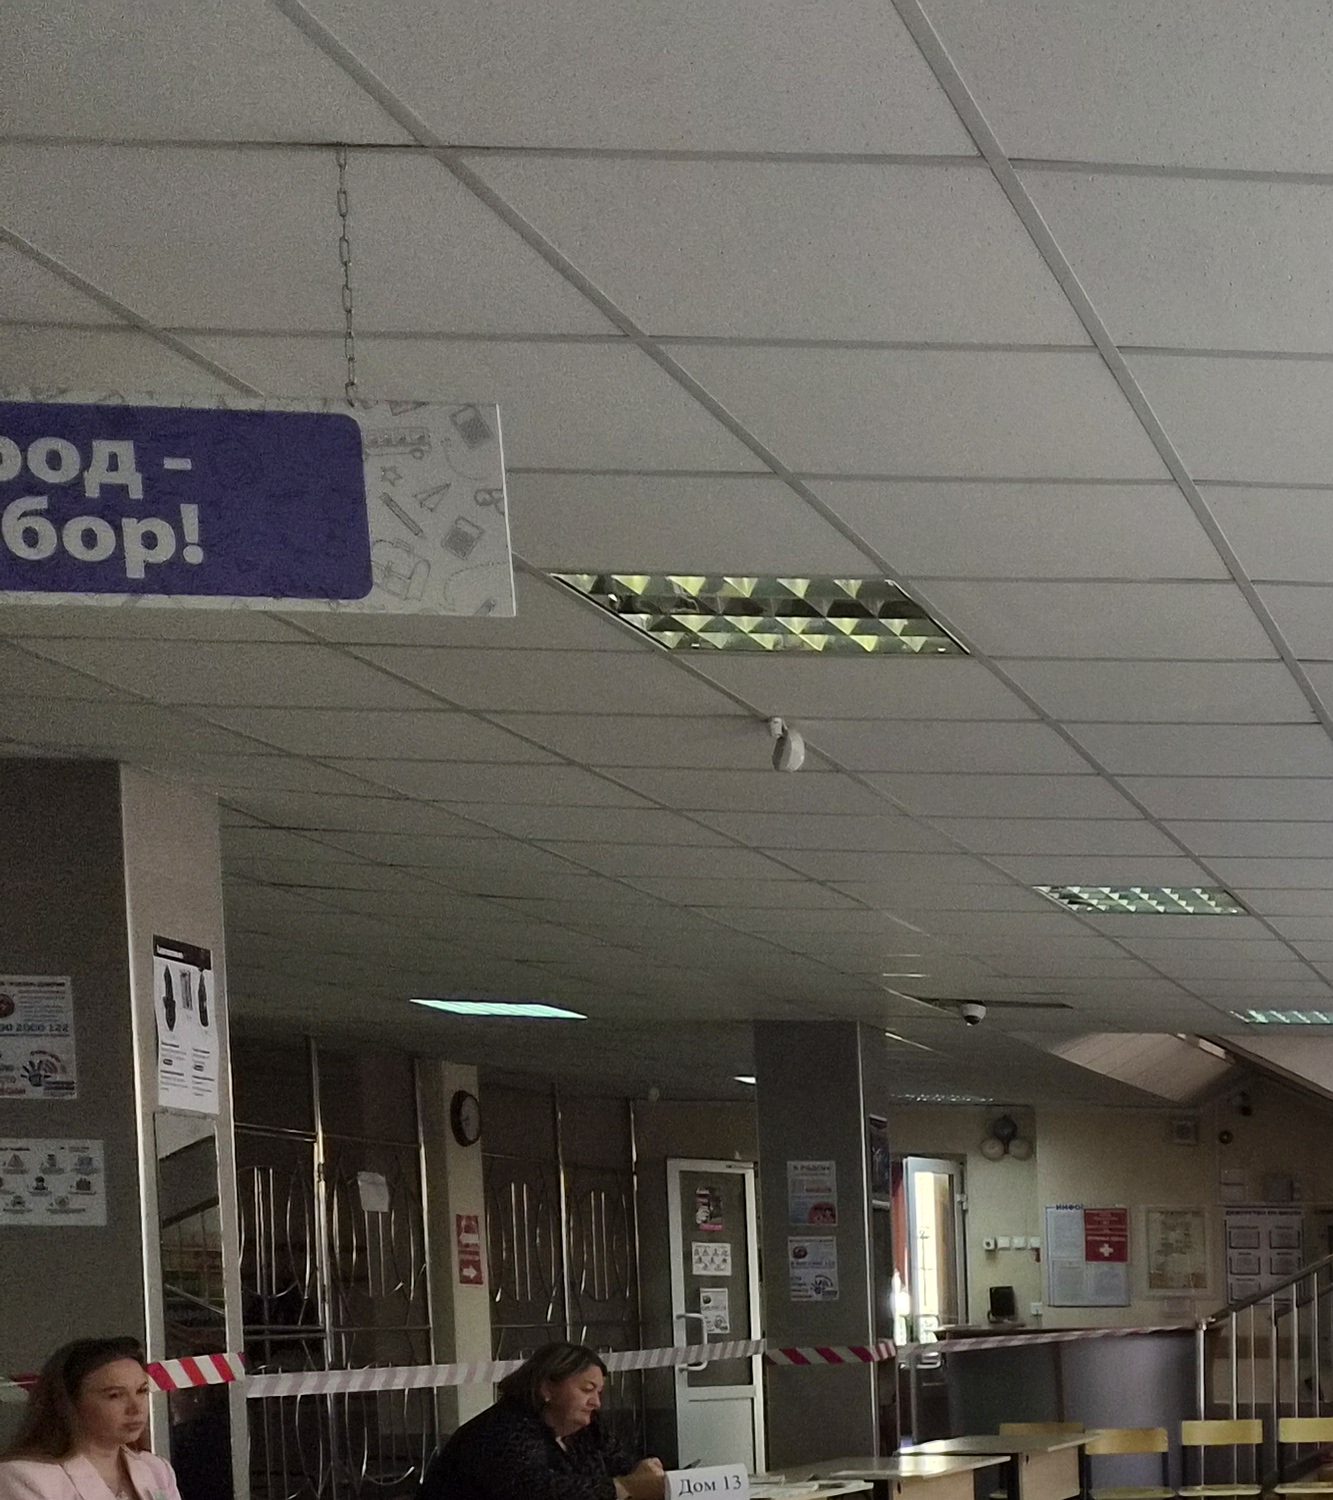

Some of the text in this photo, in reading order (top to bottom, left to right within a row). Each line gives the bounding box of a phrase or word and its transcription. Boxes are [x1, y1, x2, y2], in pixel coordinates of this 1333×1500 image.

[1056, 1203, 1084, 1211] ИНФО
[678, 1474, 743, 1496] Дом 13
